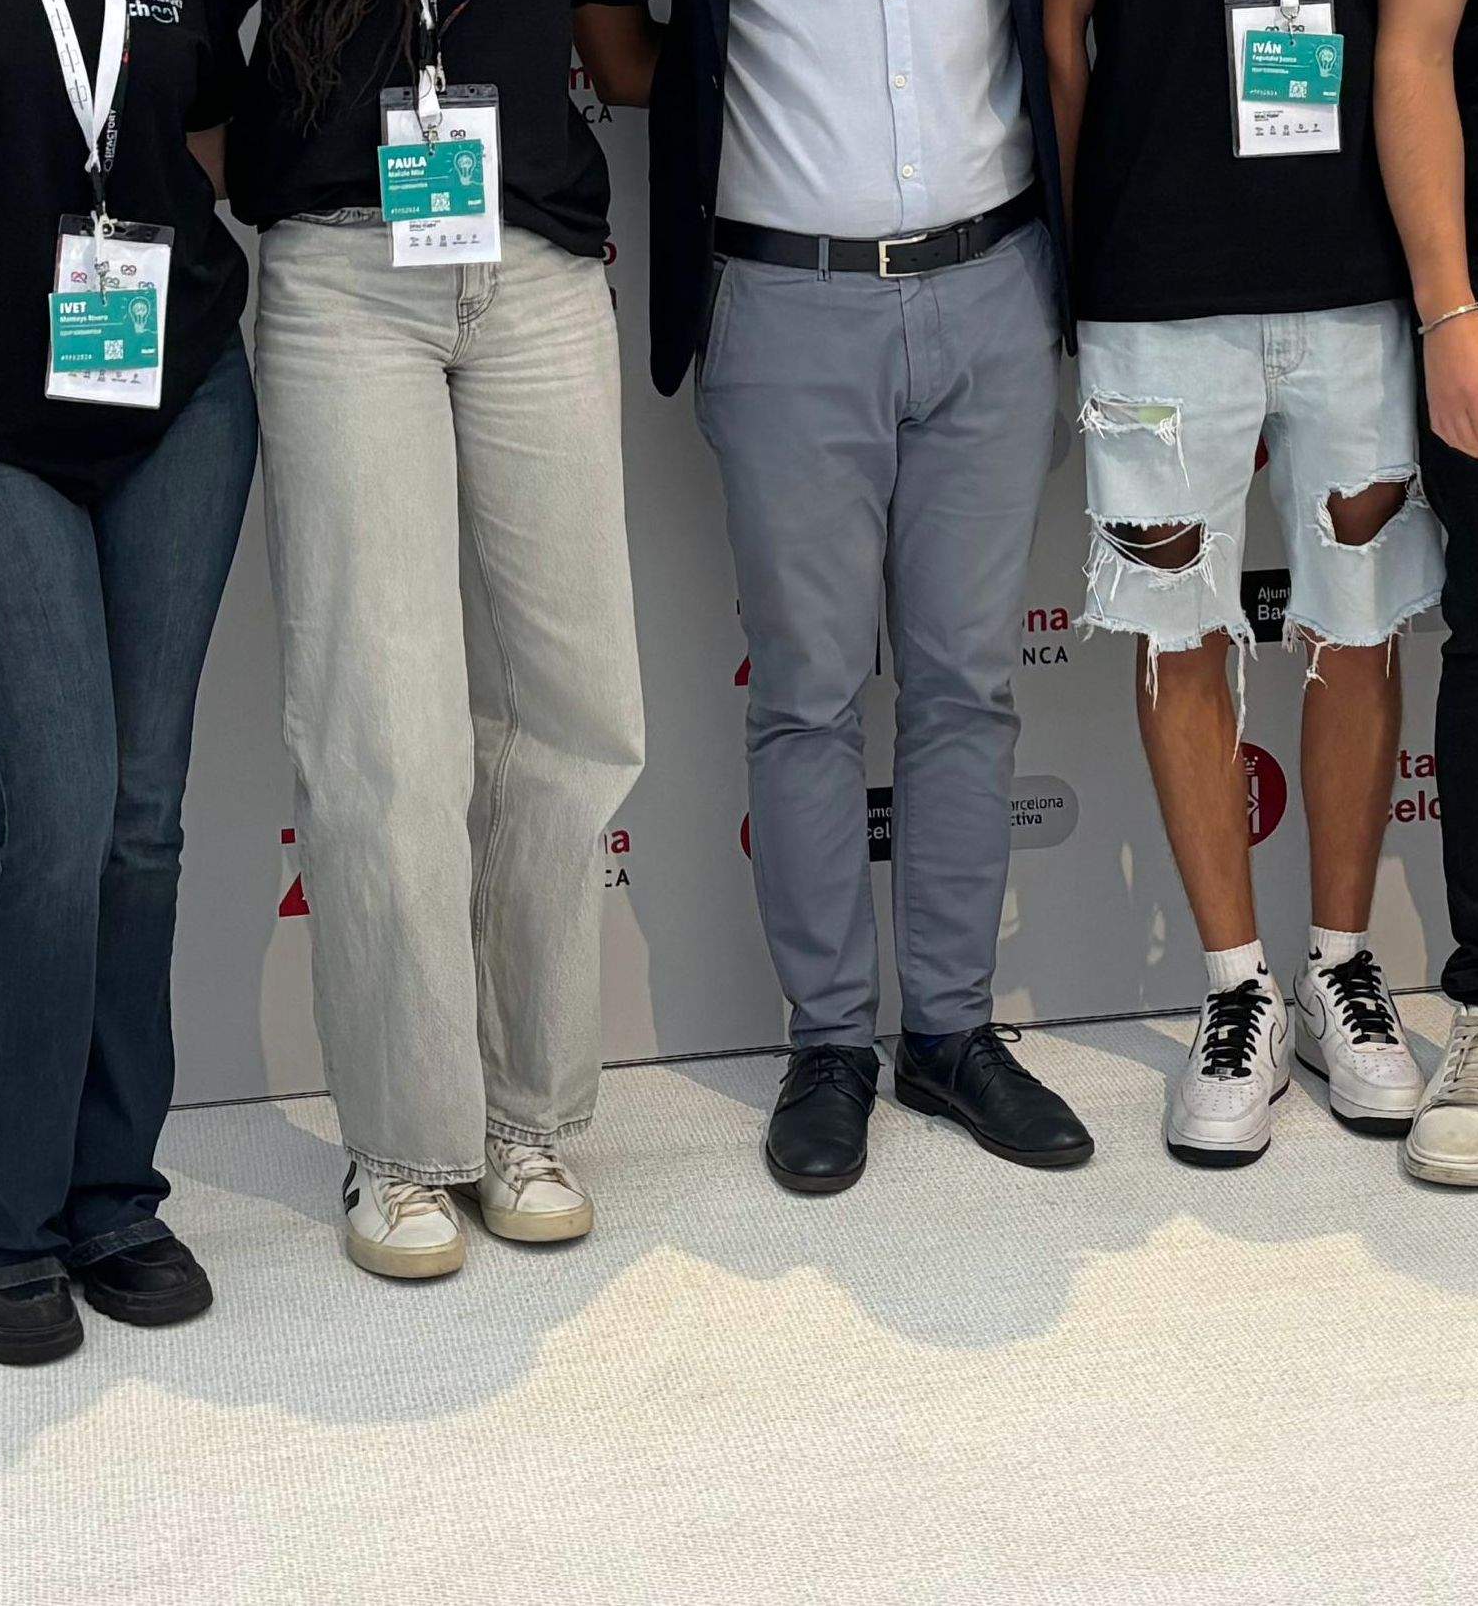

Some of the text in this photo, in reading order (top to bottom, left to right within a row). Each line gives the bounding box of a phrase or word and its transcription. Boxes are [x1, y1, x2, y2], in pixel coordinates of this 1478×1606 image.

[128, 0, 180, 24] chool
[1253, 41, 1282, 54] IVÁN
[388, 157, 427, 169] PAULA
[60, 301, 87, 314] IVET
